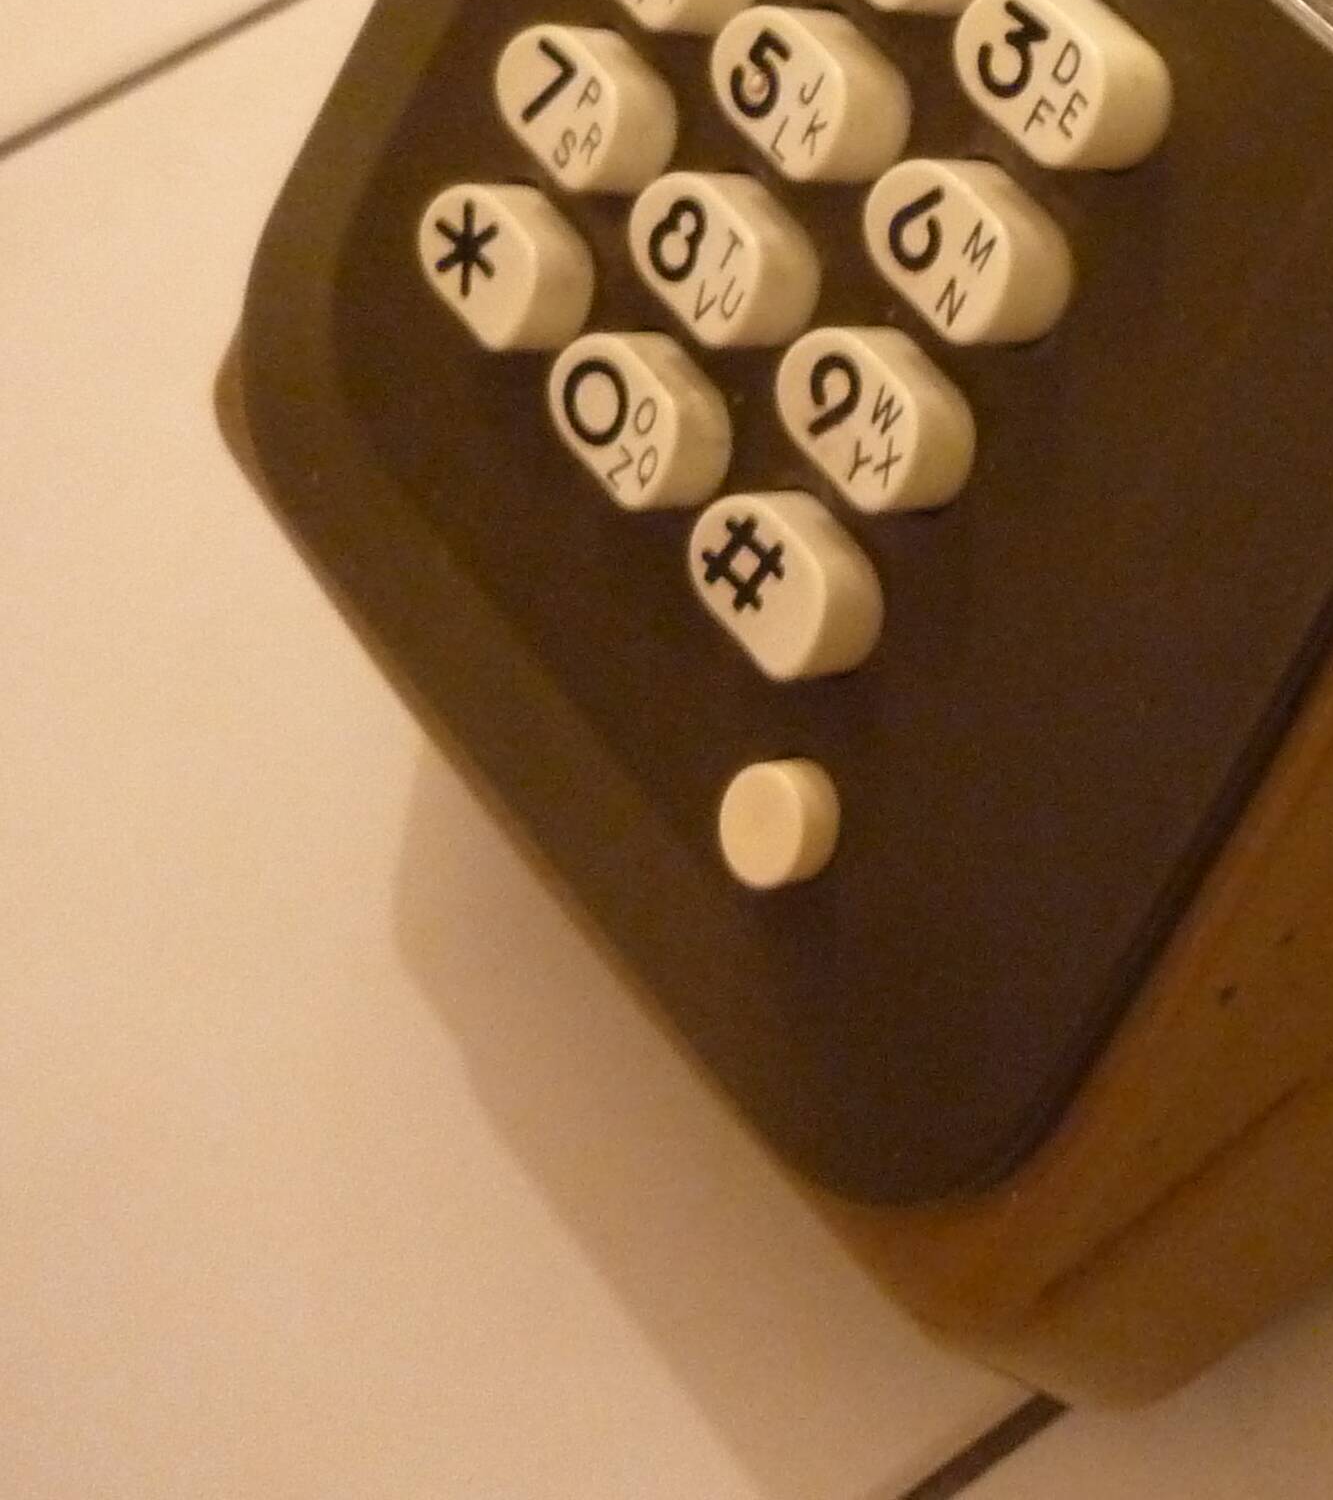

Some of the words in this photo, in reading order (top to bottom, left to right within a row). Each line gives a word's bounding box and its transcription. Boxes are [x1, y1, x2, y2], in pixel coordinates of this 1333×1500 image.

[520, 35, 579, 125] 7
[730, 27, 792, 119] 5
[647, 194, 706, 283] 8
[888, 184, 946, 273] 6
[562, 358, 629, 448] 0
[807, 353, 864, 437] 9
